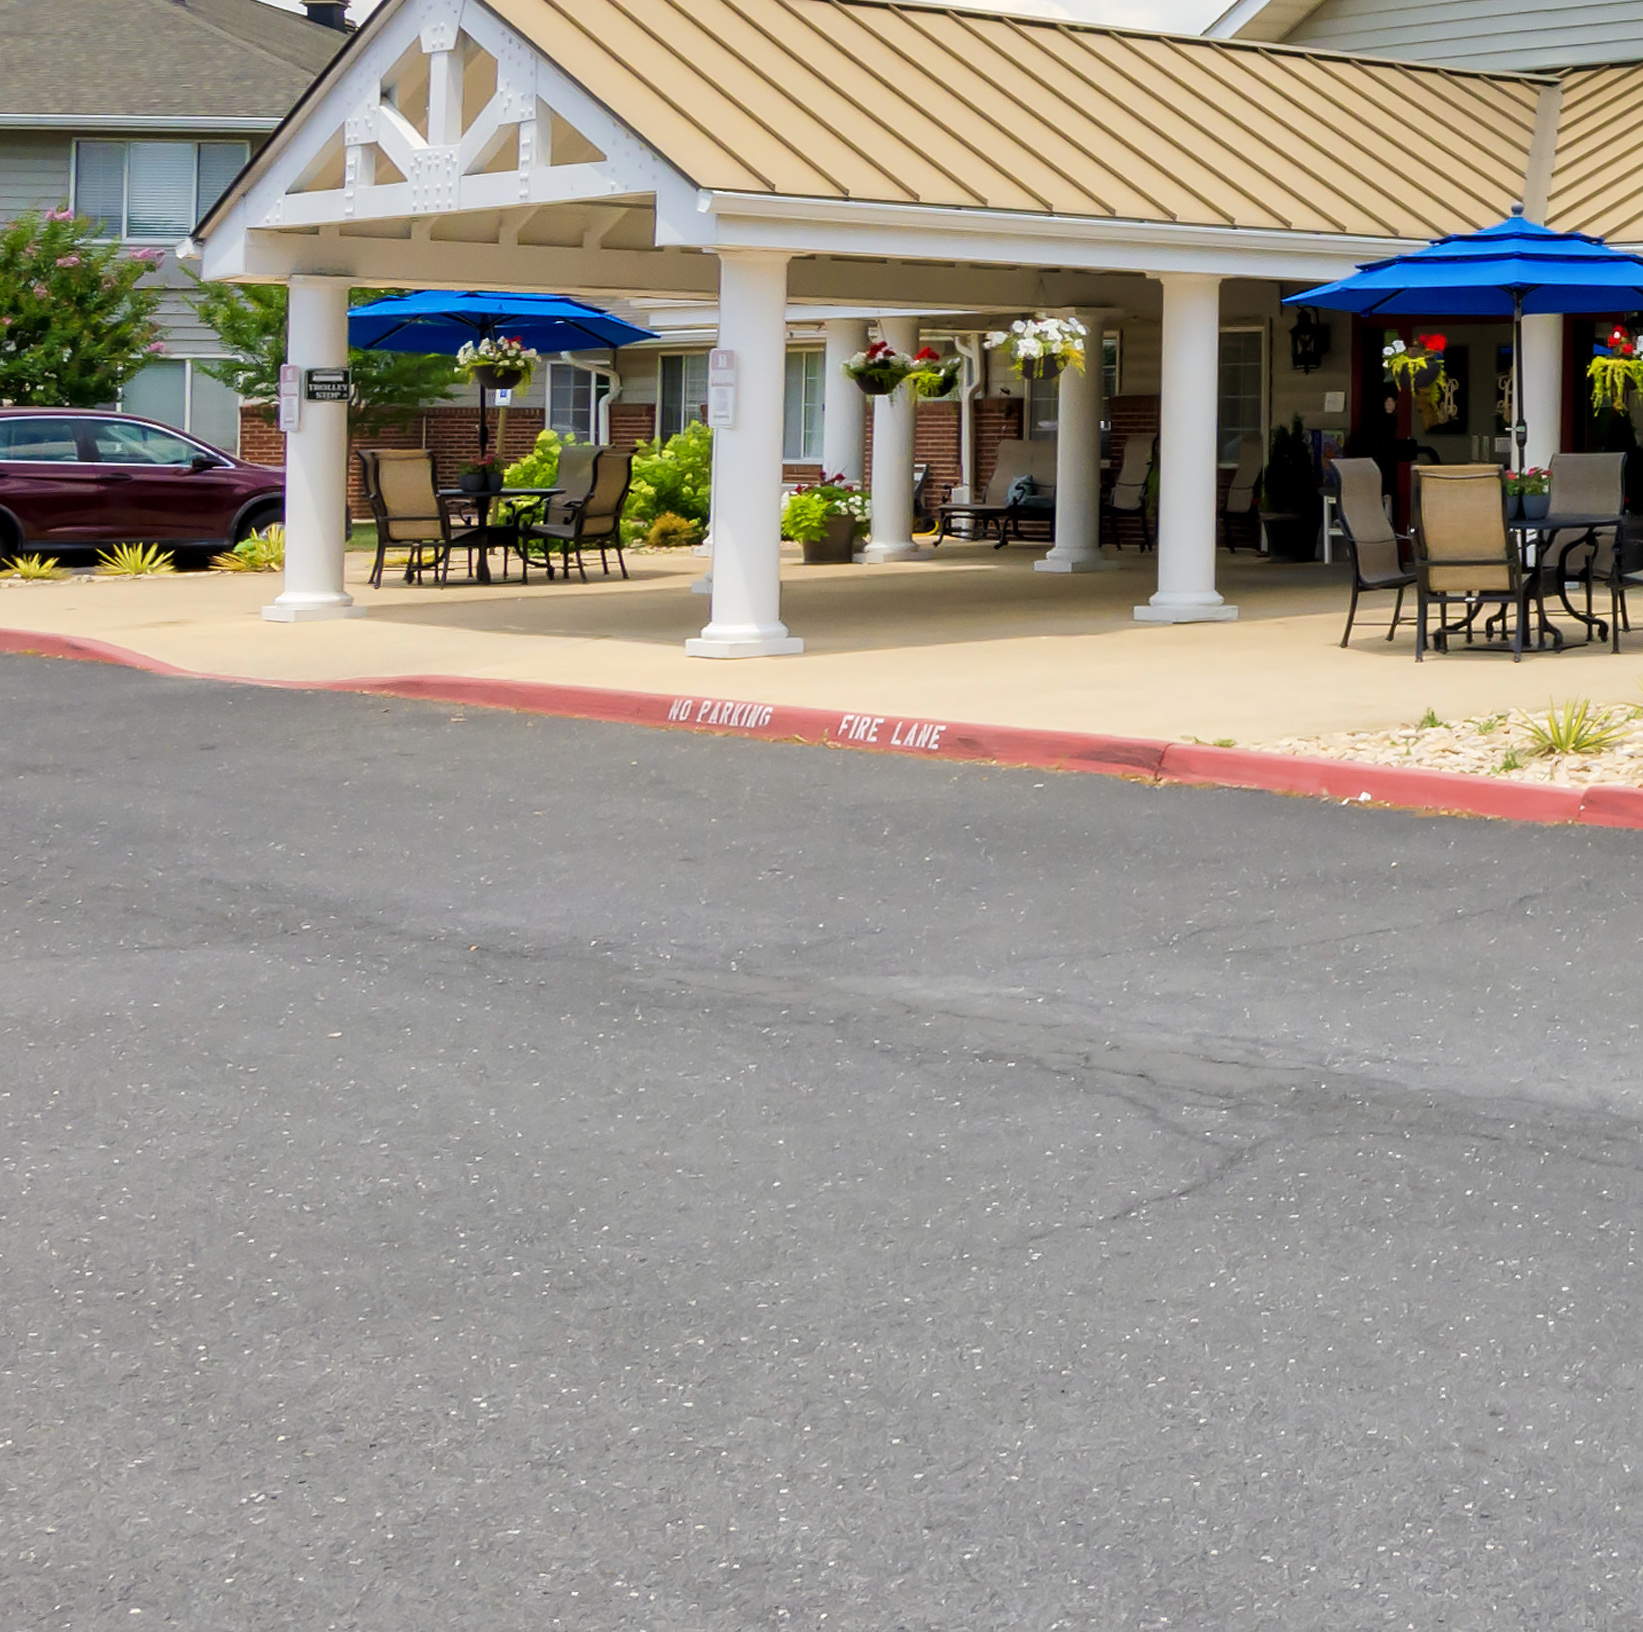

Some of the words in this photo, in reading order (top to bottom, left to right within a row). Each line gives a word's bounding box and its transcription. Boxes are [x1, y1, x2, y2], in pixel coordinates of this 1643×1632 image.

[668, 699, 693, 721] NO
[695, 700, 773, 728] PARKING
[838, 714, 884, 743] FIRE
[890, 721, 946, 750] LANE
